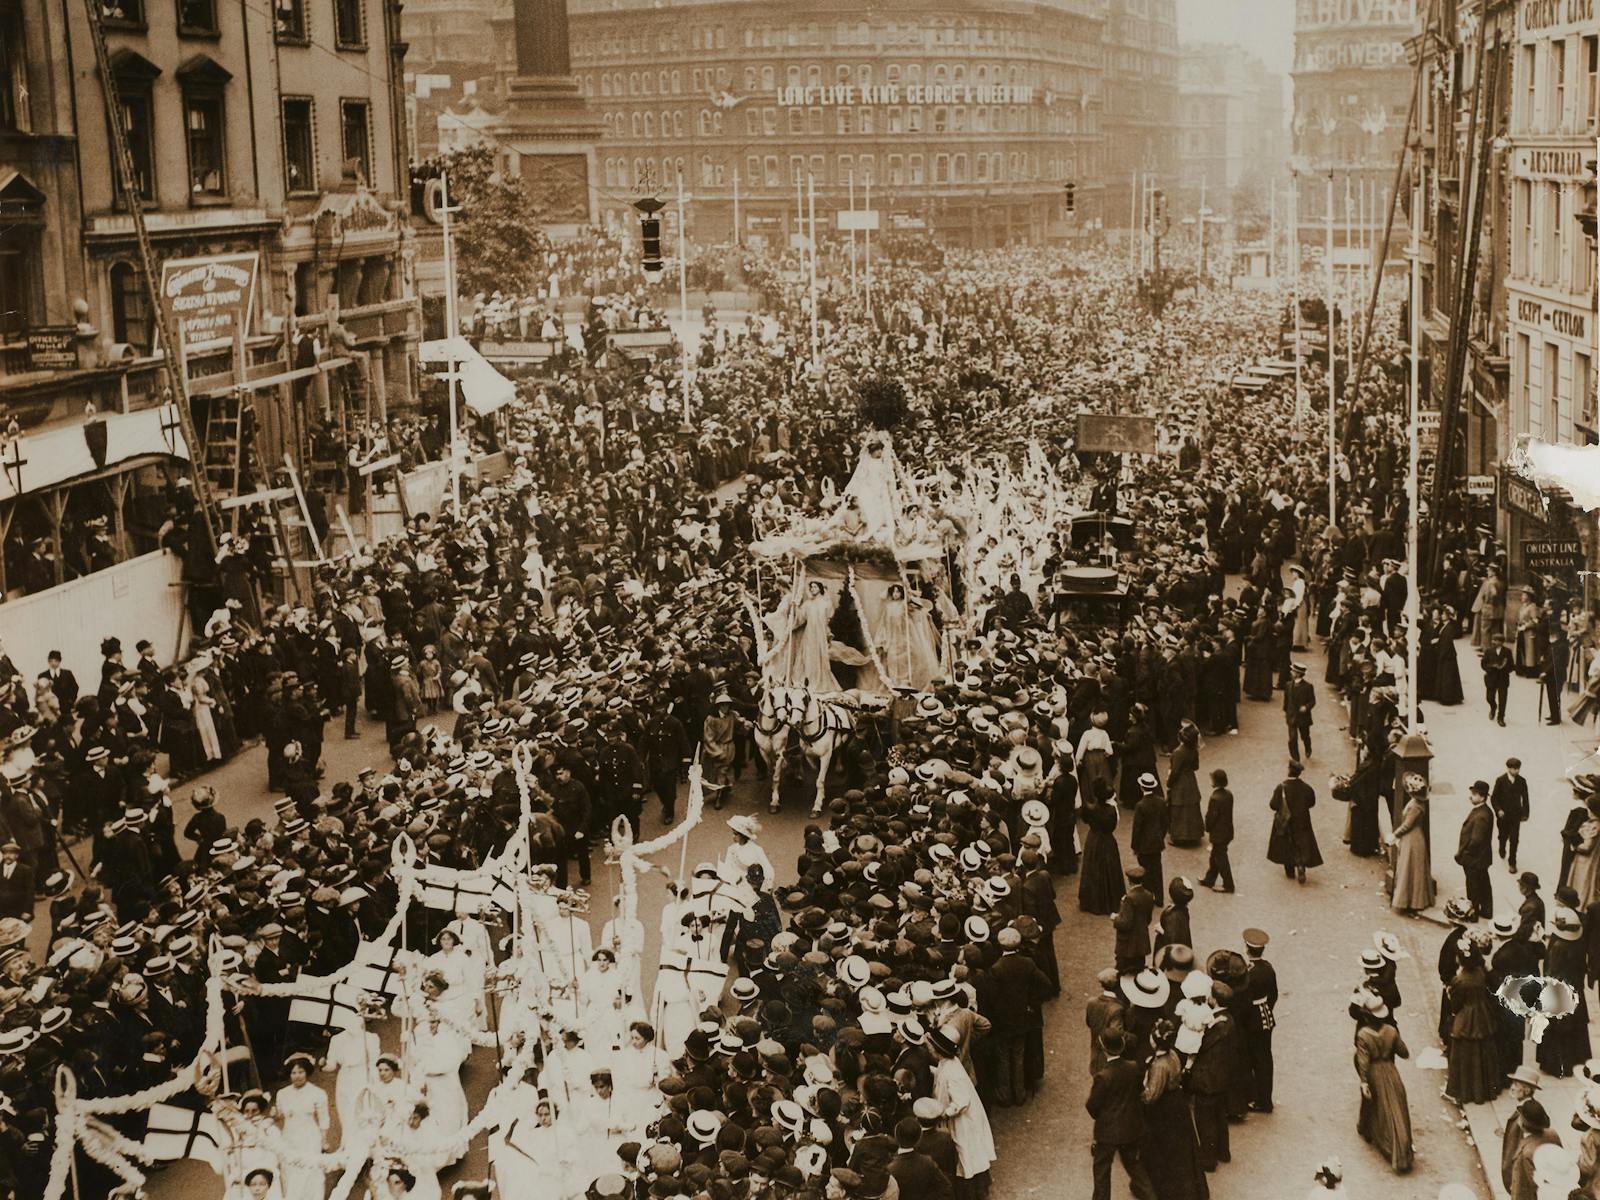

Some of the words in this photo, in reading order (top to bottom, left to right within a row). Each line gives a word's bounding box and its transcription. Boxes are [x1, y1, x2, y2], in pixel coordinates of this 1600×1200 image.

[1525, 0, 1559, 30] ORIENT
[1567, 0, 1593, 24] LINE
[777, 86, 814, 106] LONG
[821, 83, 855, 105] LIVE
[862, 83, 899, 105] KING
[907, 85, 961, 105] GEORGE
[977, 85, 1010, 104] QUEEN
[1530, 151, 1582, 176] AUSTRALIA
[1518, 299, 1542, 325] EGYPT
[1552, 309, 1585, 338] CEYLON
[1469, 481, 1495, 490] CUNARD
[1526, 543, 1559, 554] ORIENT
[1560, 543, 1579, 553] LINE
[1528, 559, 1575, 567] AUSTRALIA
